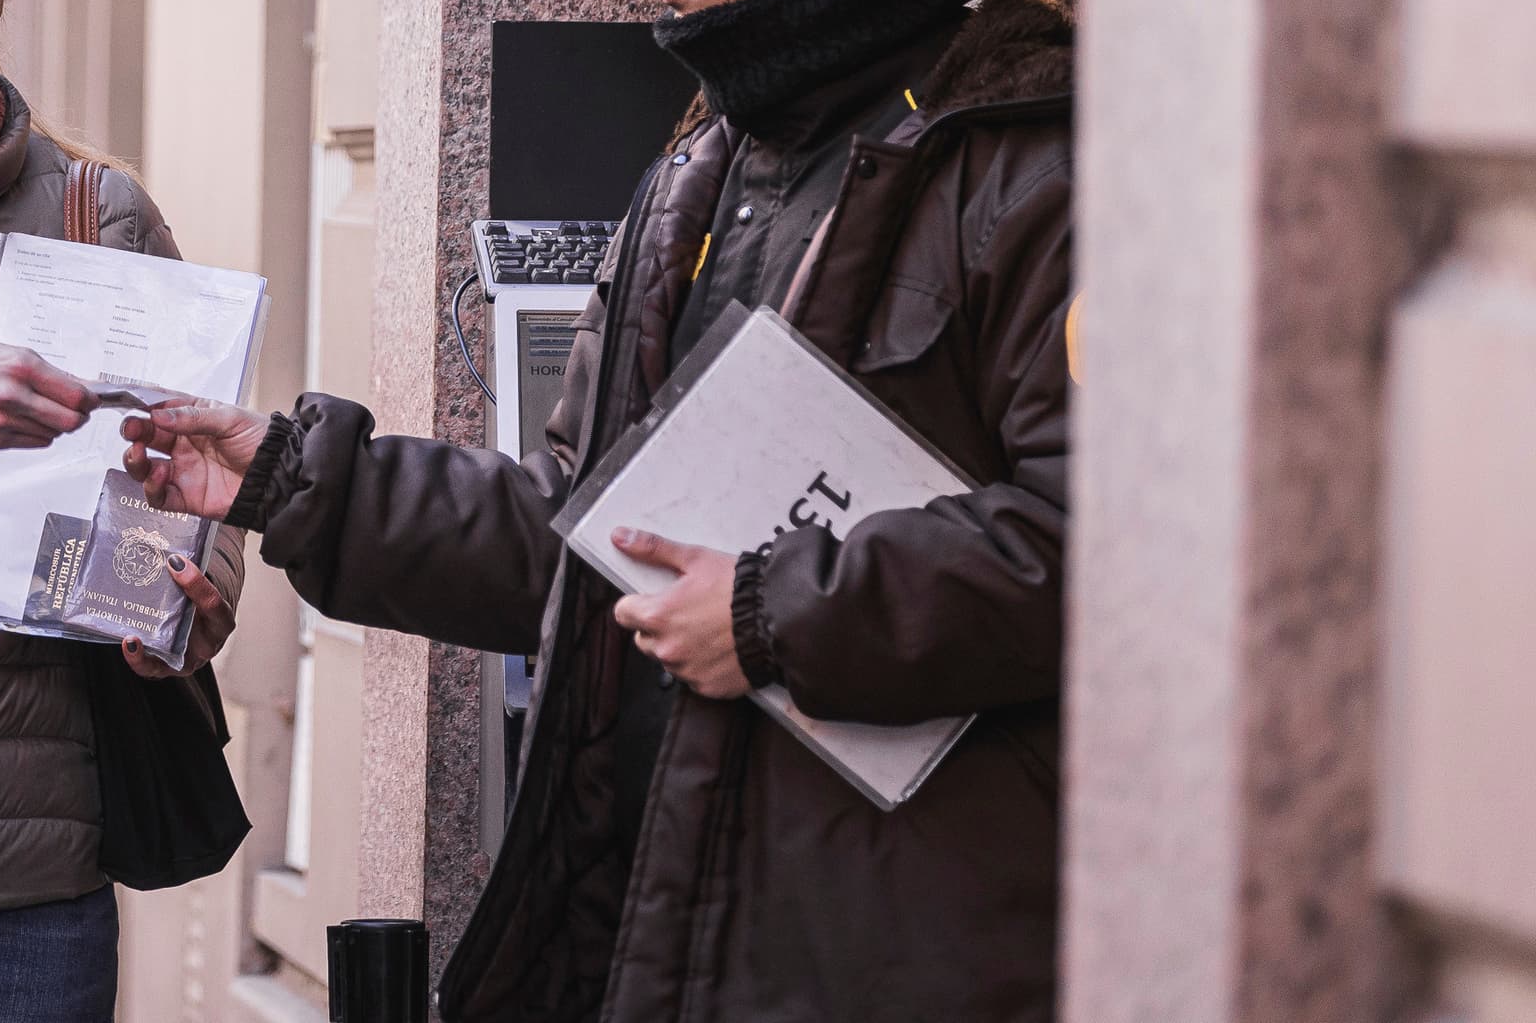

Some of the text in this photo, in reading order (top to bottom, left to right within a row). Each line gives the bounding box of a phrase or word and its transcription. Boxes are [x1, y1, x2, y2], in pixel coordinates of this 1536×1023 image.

[120, 495, 188, 522] PASSPORTO
[46, 547, 62, 595] MERCOSUR
[52, 538, 77, 610] REPÚBLICA
[86, 606, 159, 633] UNIONE EUROPEA
